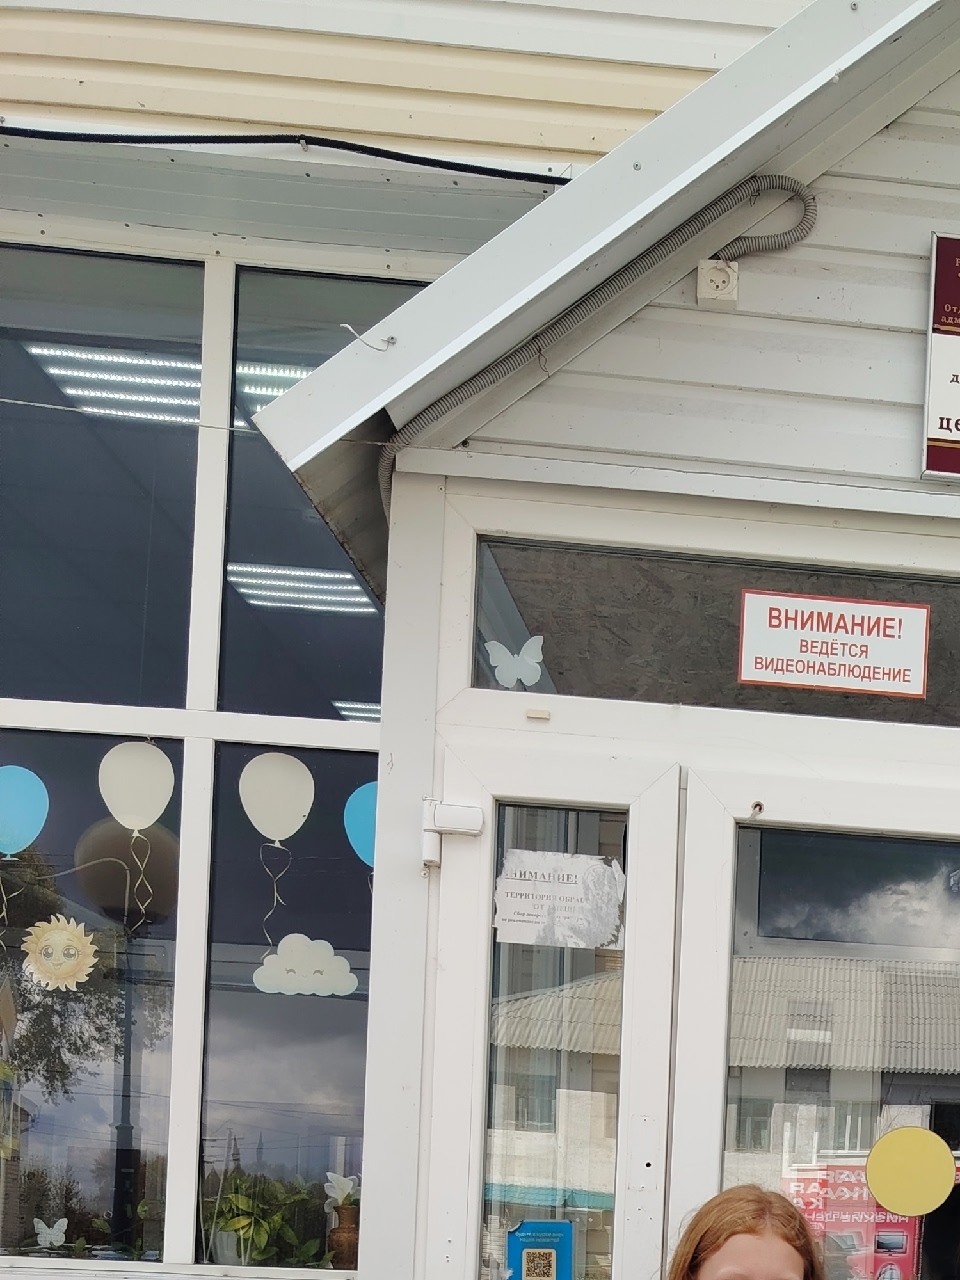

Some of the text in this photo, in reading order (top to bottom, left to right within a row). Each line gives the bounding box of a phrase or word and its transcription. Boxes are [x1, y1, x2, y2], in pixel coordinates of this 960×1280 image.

[768, 606, 903, 640] ВНИМАНИЕ!
[799, 639, 869, 659] ВЕДЁТСЯ
[754, 656, 912, 683] ВИДЕОНАБЛЮДЕНИЕ
[506, 870, 578, 884] НИМАНИЕ!
